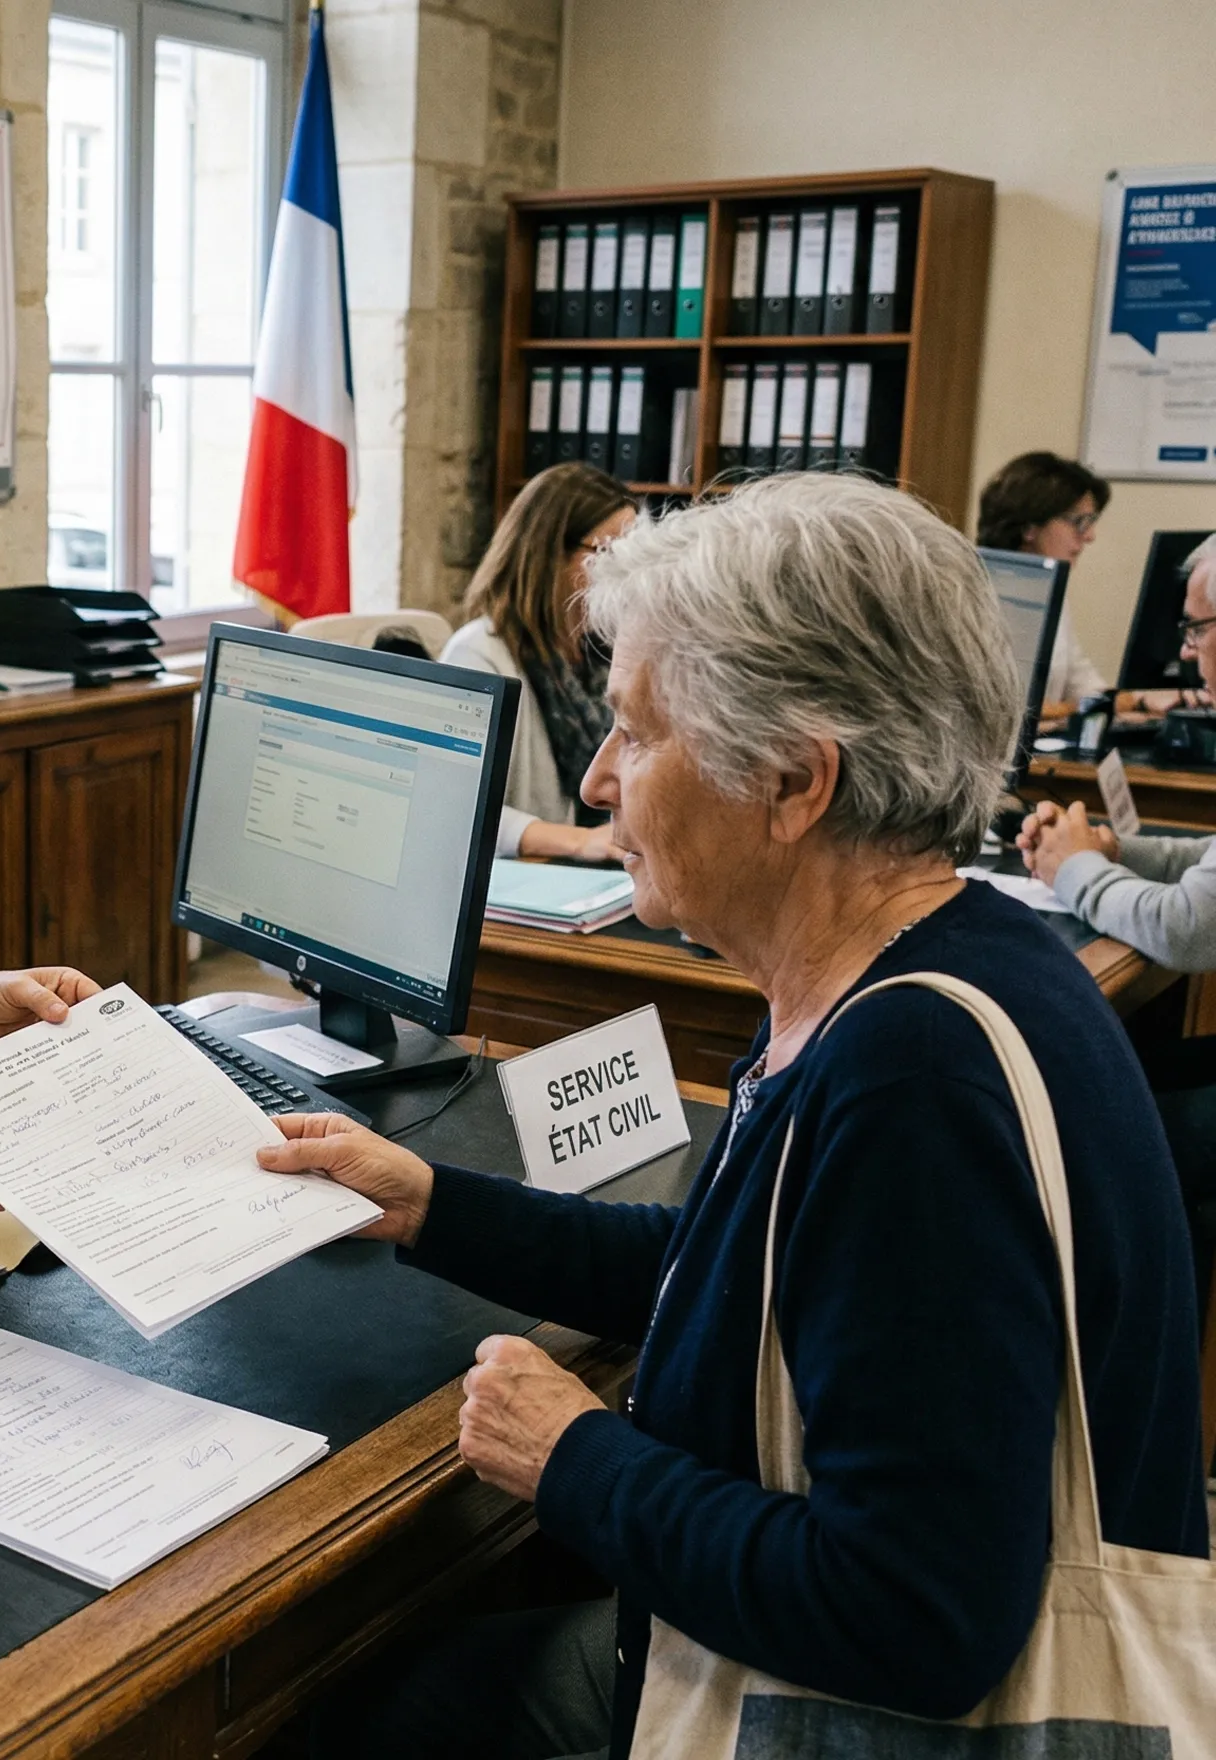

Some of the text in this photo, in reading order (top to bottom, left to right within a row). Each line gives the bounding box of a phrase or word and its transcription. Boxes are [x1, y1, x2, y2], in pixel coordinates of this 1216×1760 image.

[547, 1050, 639, 1111] SERVICE
[548, 1093, 661, 1165] ÉTAT CIVIL
